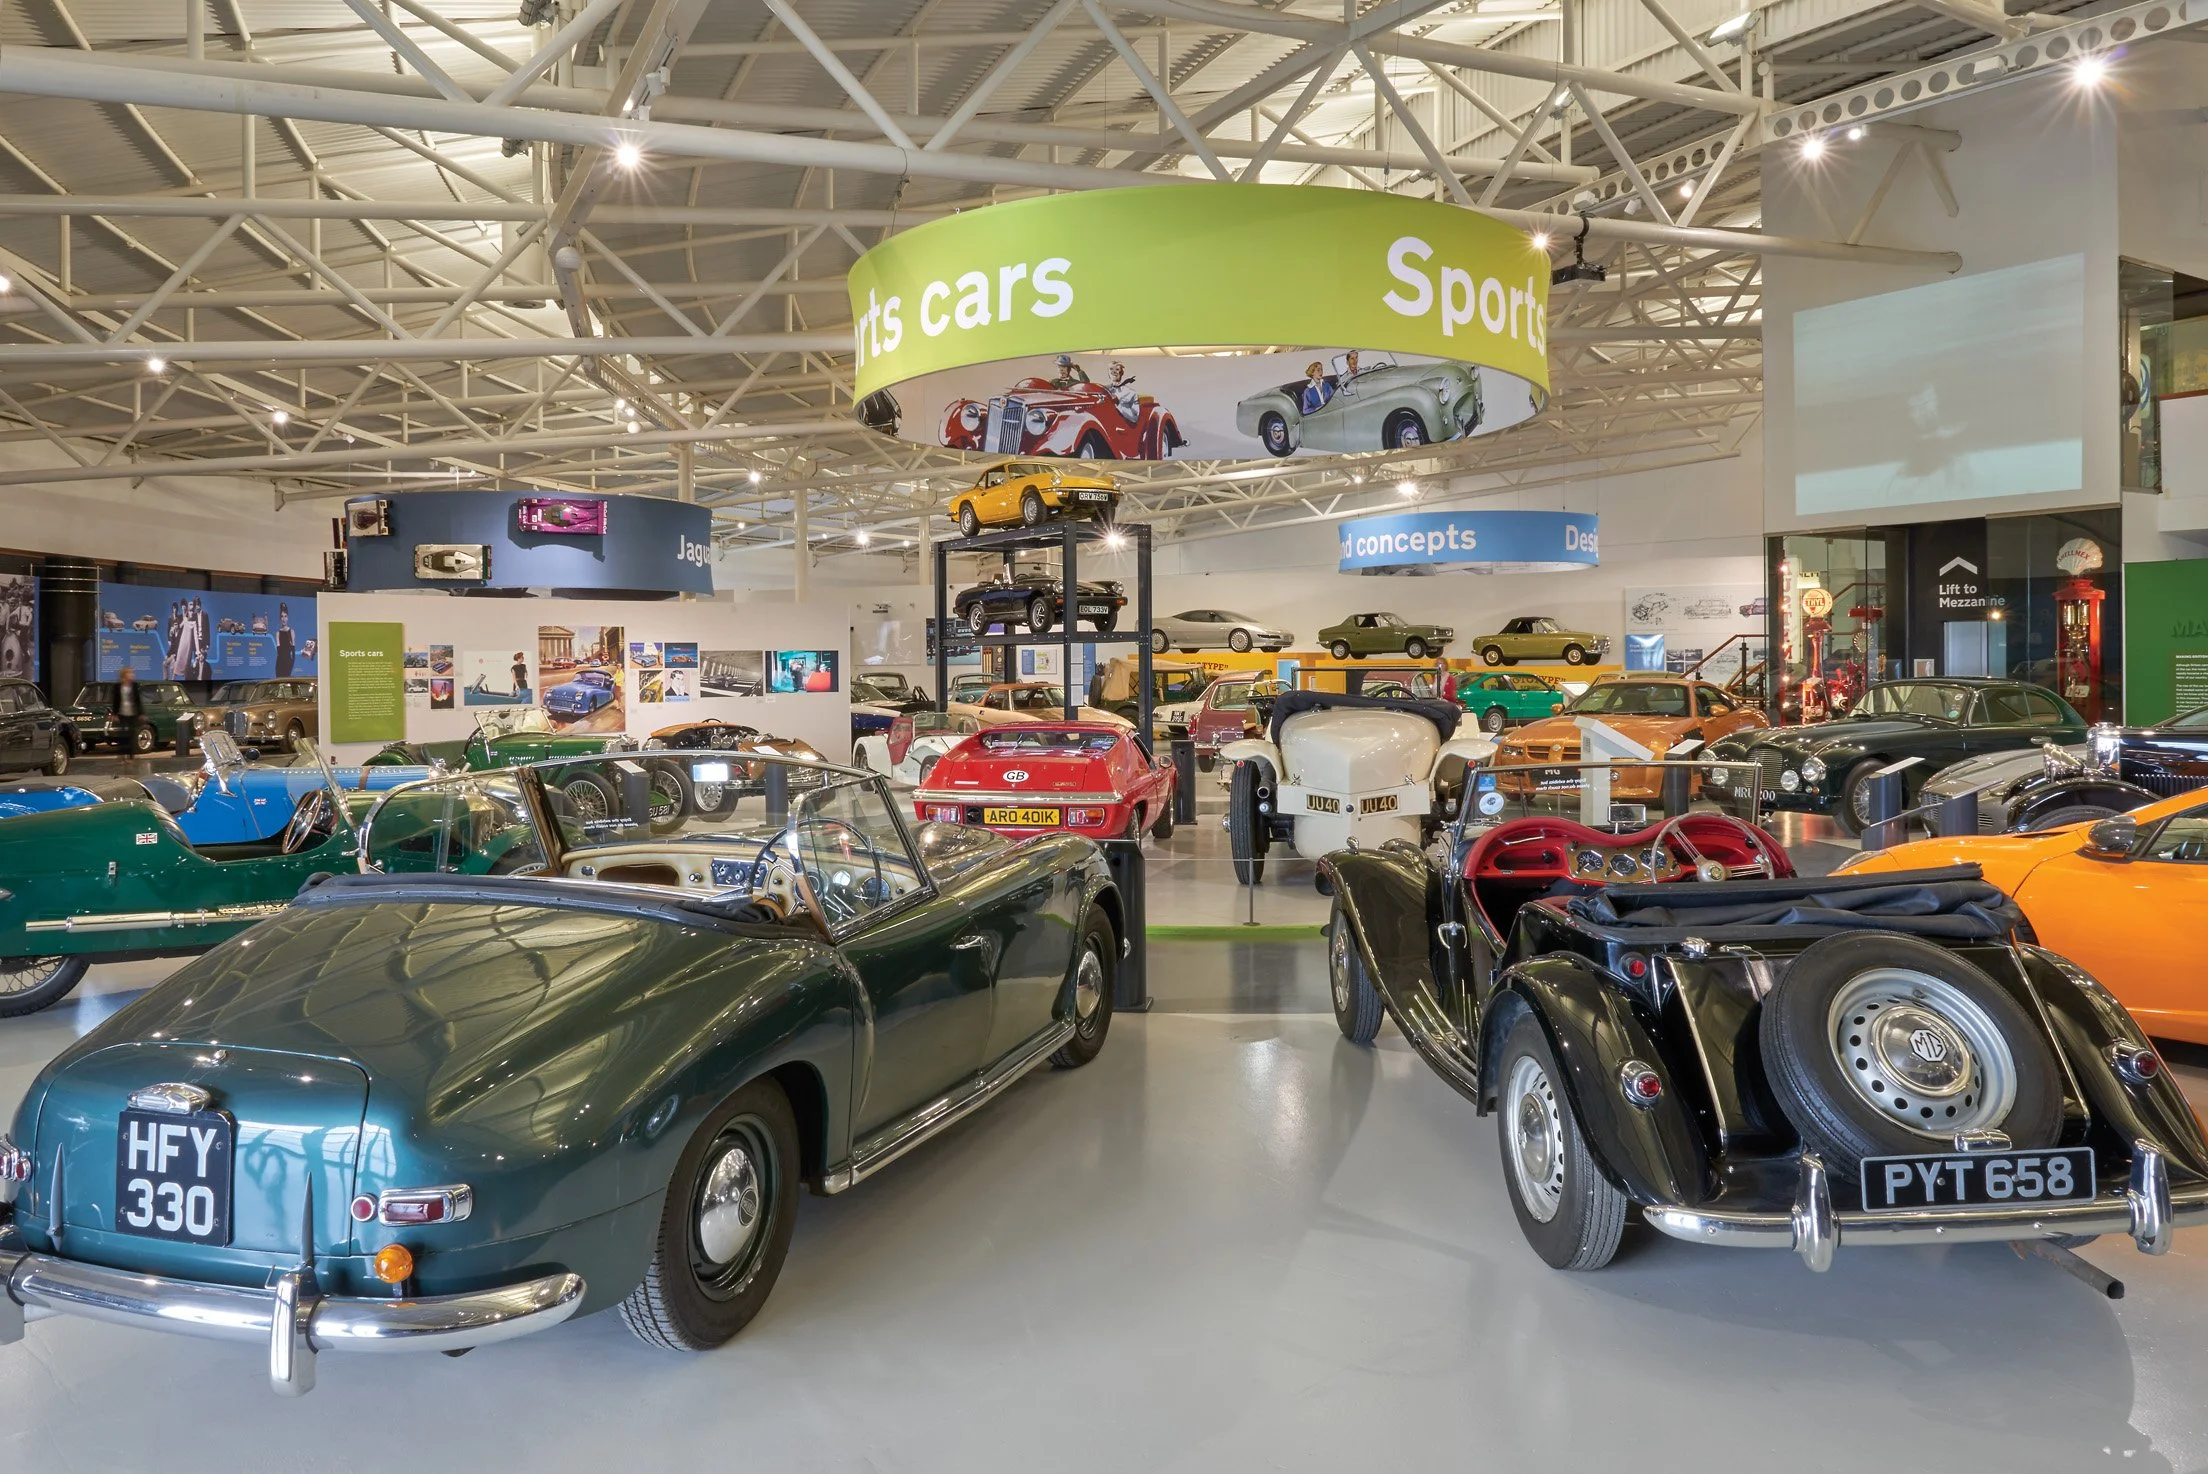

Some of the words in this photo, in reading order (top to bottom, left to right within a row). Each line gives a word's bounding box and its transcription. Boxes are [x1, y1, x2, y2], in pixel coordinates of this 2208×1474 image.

[1382, 236, 1545, 357] Sports
[855, 287, 902, 375] rts
[920, 257, 1074, 337] cars
[1356, 524, 1477, 556] concepts
[1939, 584, 1960, 595] Lift
[1963, 584, 1978, 594] to
[1939, 596, 2006, 608] Mezzanine
[339, 650, 366, 658] Sports
[1006, 771, 1026, 781] GB
[1307, 795, 1324, 810] UU
[1325, 798, 1340, 813] 40
[1361, 799, 1378, 814] UU
[1380, 796, 1397, 811] 40
[989, 810, 1018, 822] ARO
[1022, 811, 1054, 823] 401K
[1914, 1031, 1944, 1059] MG
[128, 1120, 217, 1178] HFY
[1884, 1160, 1974, 1205] PYT
[1985, 1156, 2074, 1199] 658
[127, 1178, 214, 1236] 330
